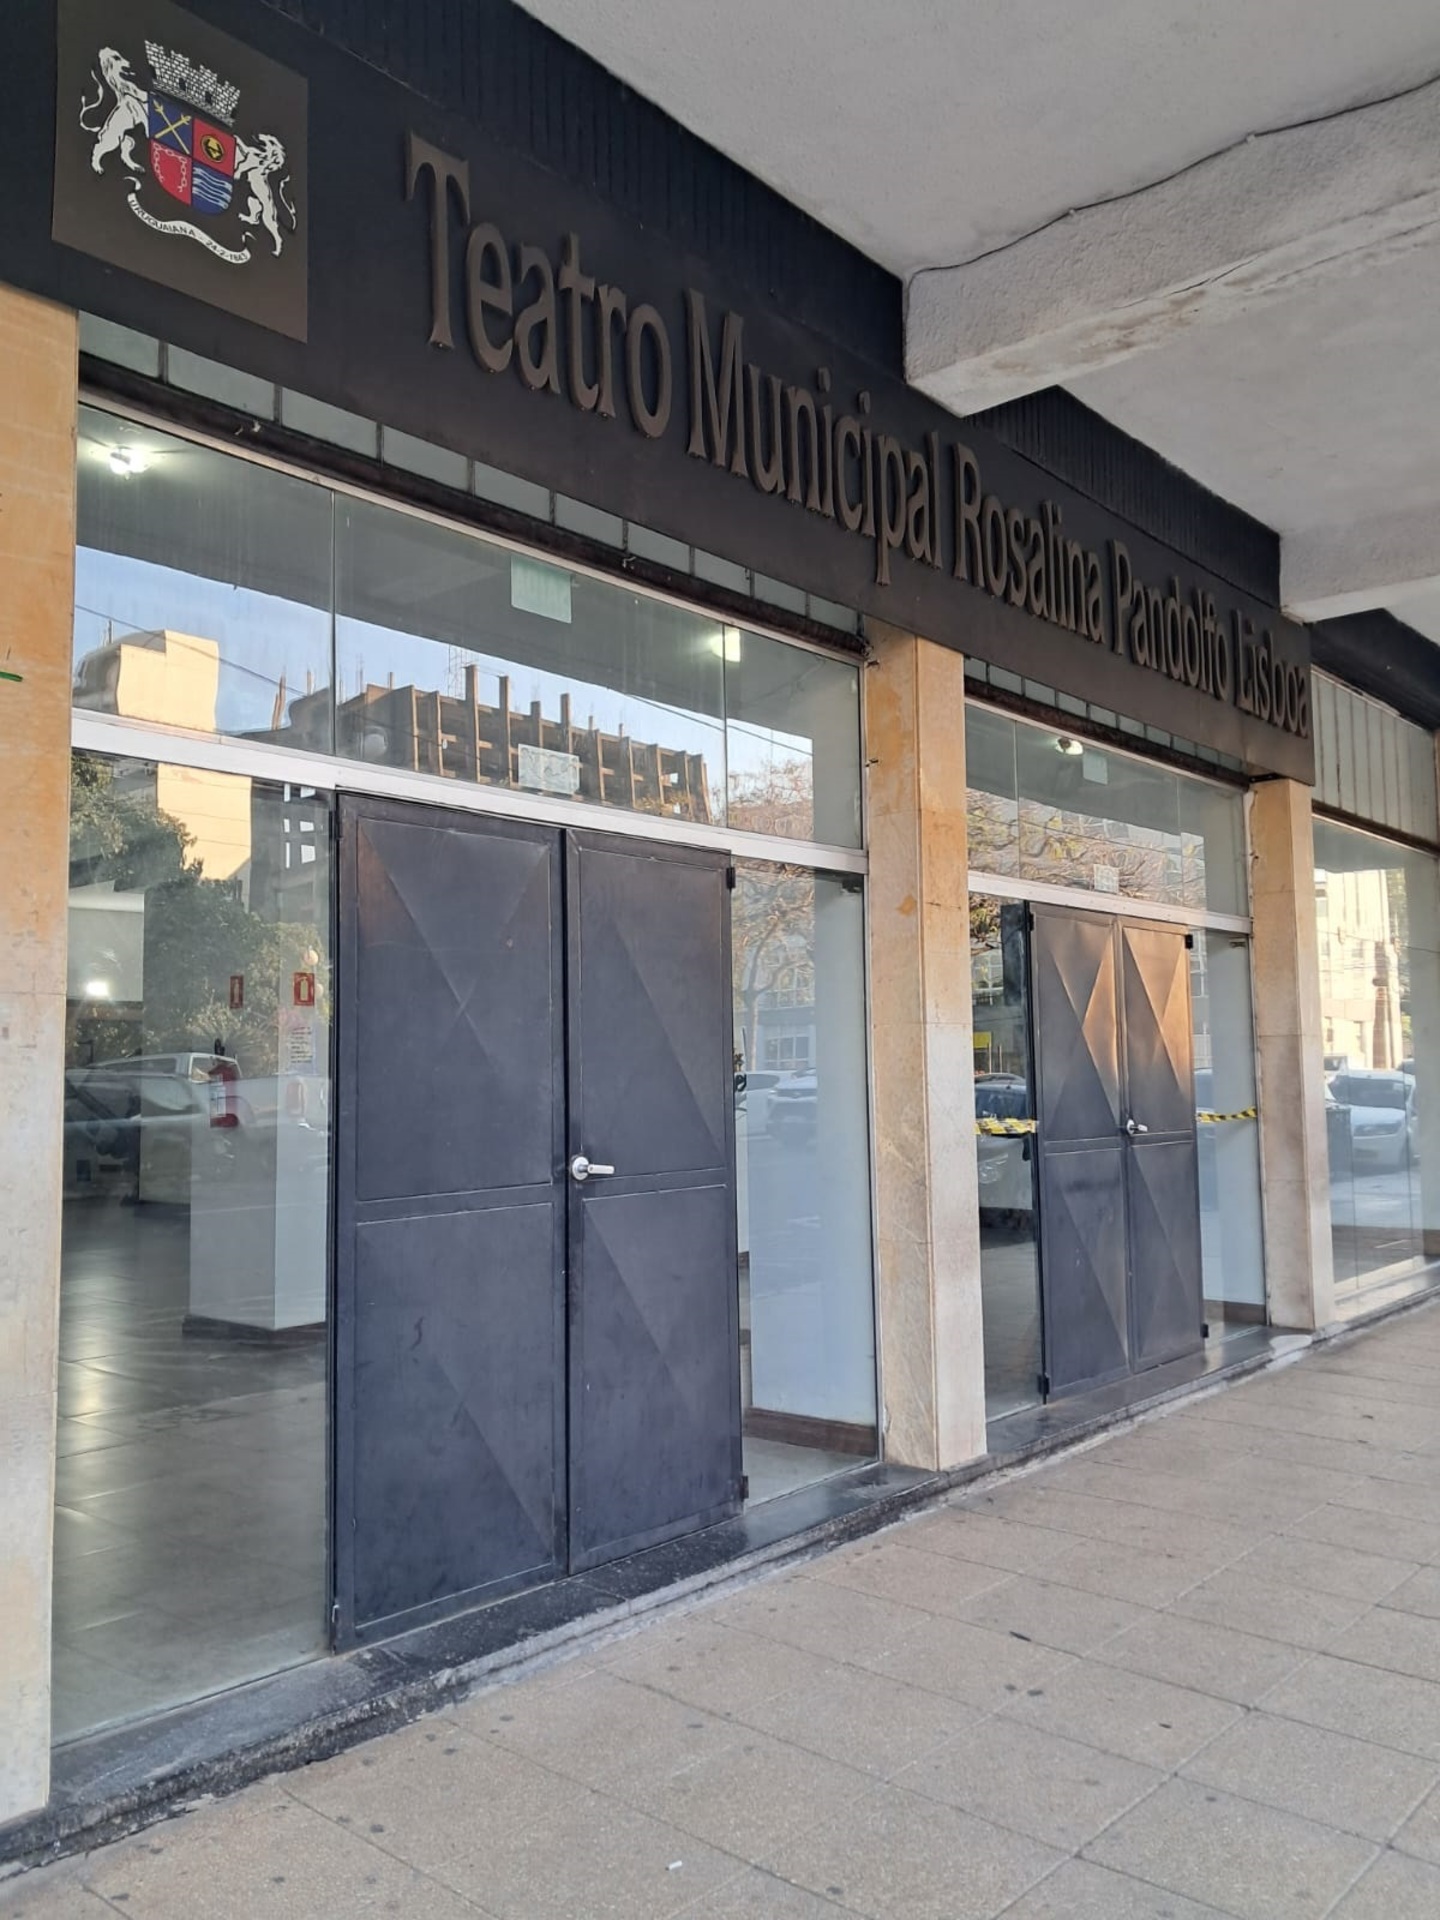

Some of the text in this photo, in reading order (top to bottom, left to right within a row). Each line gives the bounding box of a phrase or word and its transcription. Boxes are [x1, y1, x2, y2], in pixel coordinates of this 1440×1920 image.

[129, 198, 196, 237] URUGUAIANA
[405, 129, 1309, 738] Teatro Municipal Rosalina Pandolfo Lisboa
